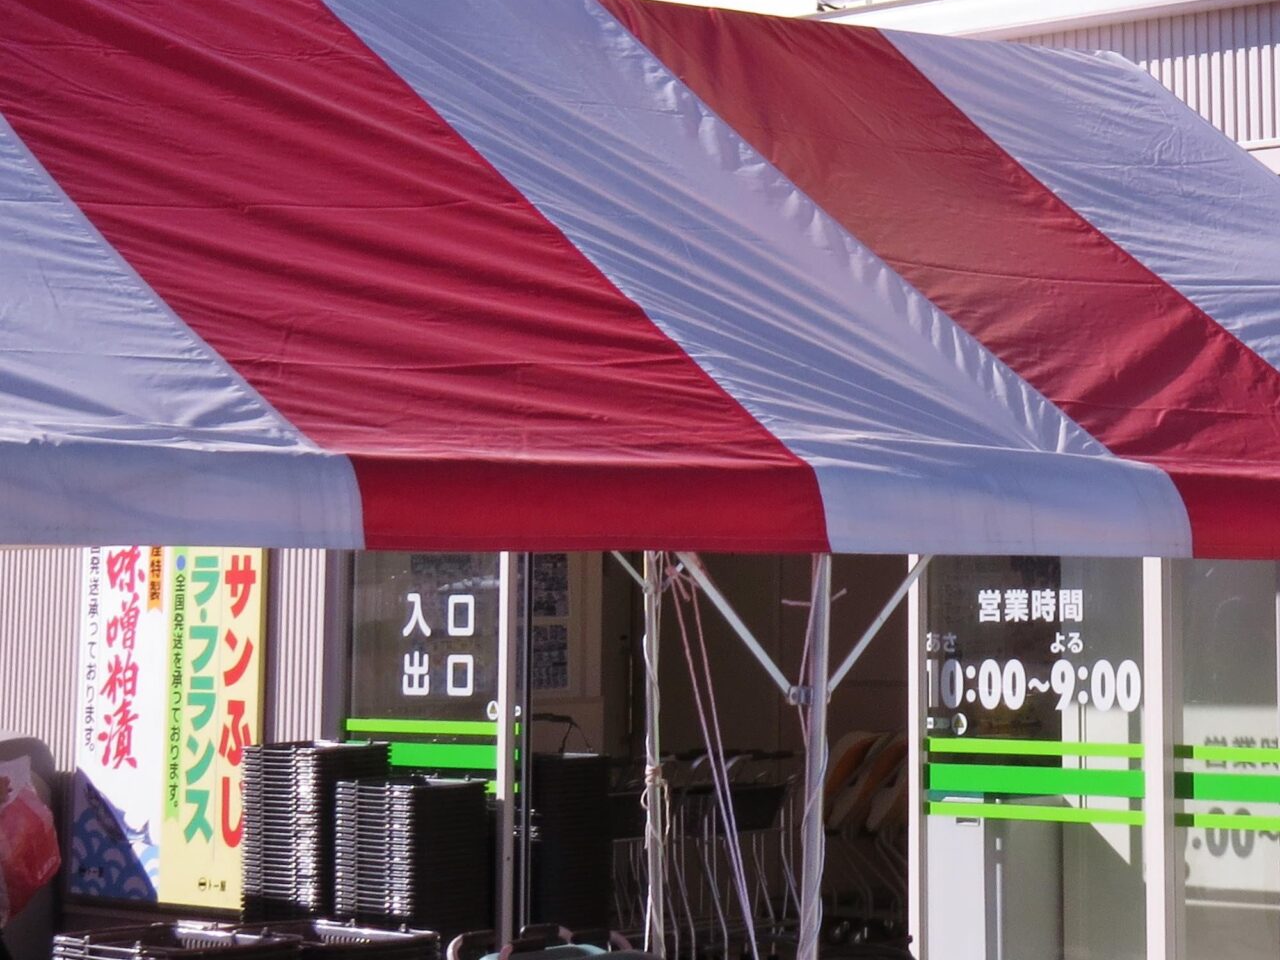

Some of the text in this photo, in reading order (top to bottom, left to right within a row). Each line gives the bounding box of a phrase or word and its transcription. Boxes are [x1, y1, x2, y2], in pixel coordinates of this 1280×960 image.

[402, 592, 475, 637] 入口
[977, 588, 1084, 623] 営業時間
[1049, 631, 1084, 654] よる
[402, 650, 474, 697] 出口
